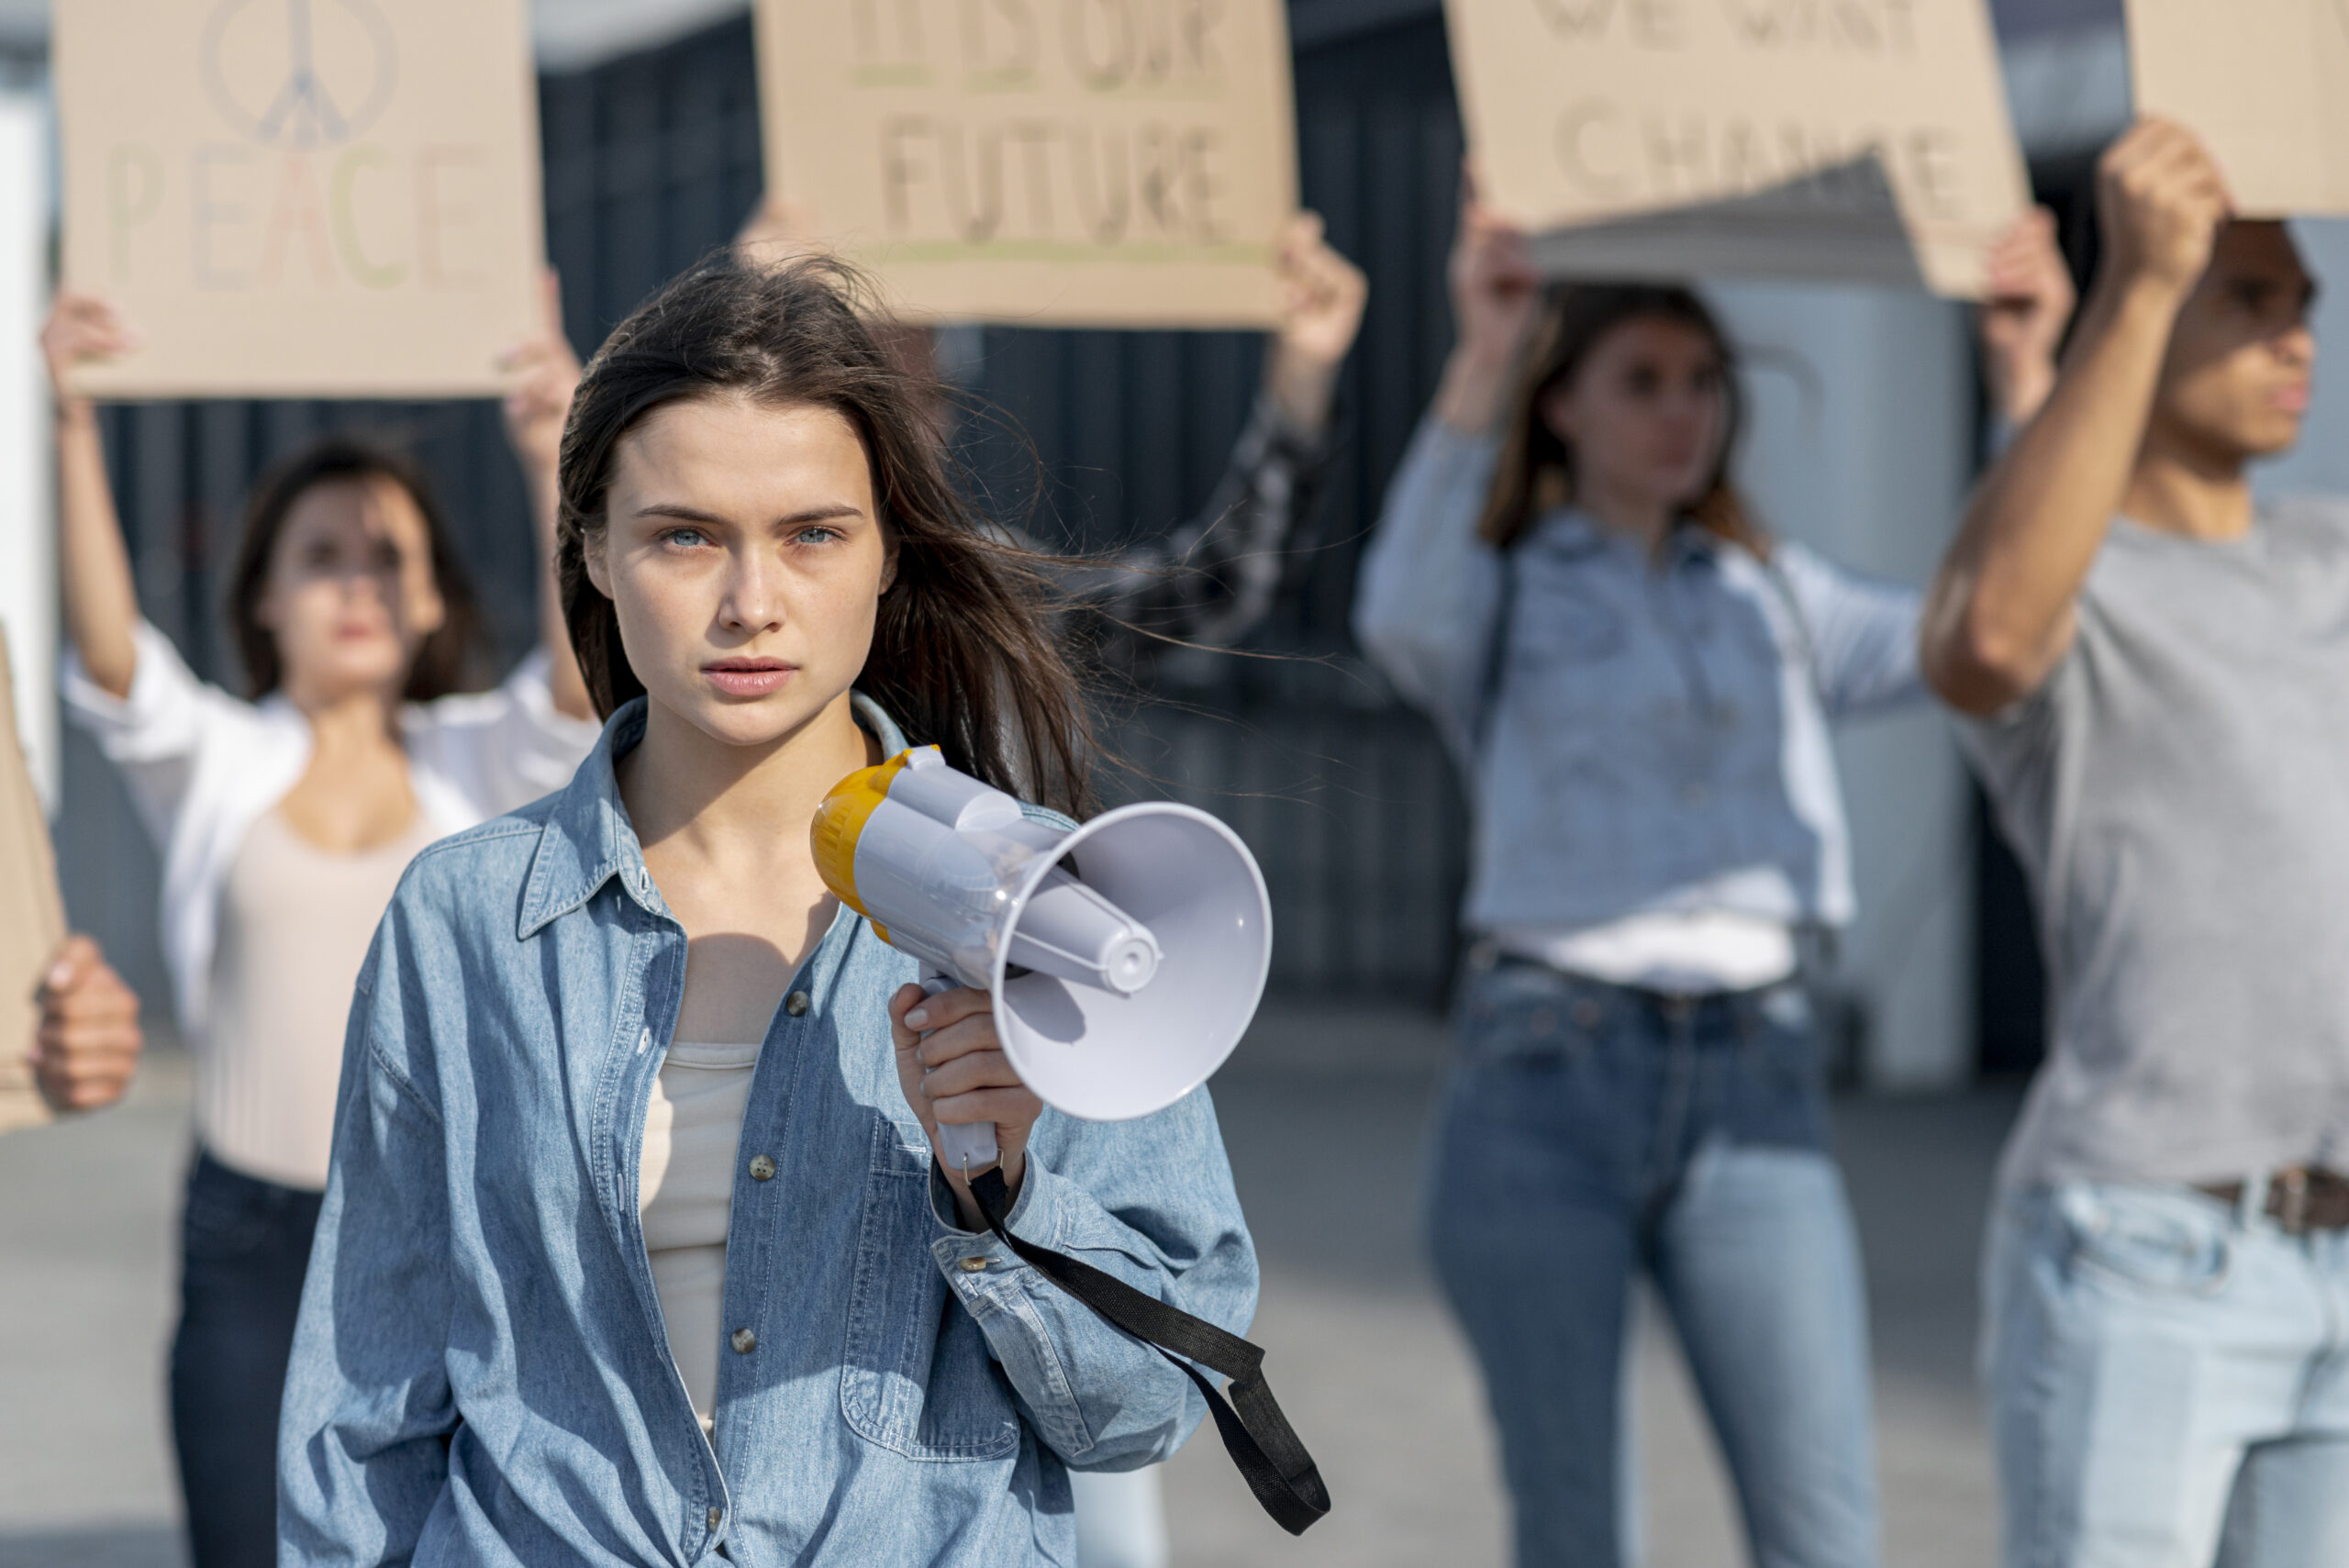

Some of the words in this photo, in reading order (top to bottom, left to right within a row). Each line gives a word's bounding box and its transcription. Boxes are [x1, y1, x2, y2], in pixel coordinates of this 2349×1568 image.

[104, 140, 493, 293] PEACE
[877, 112, 1237, 248] FUTURE
[1552, 94, 1969, 220] CHANE
